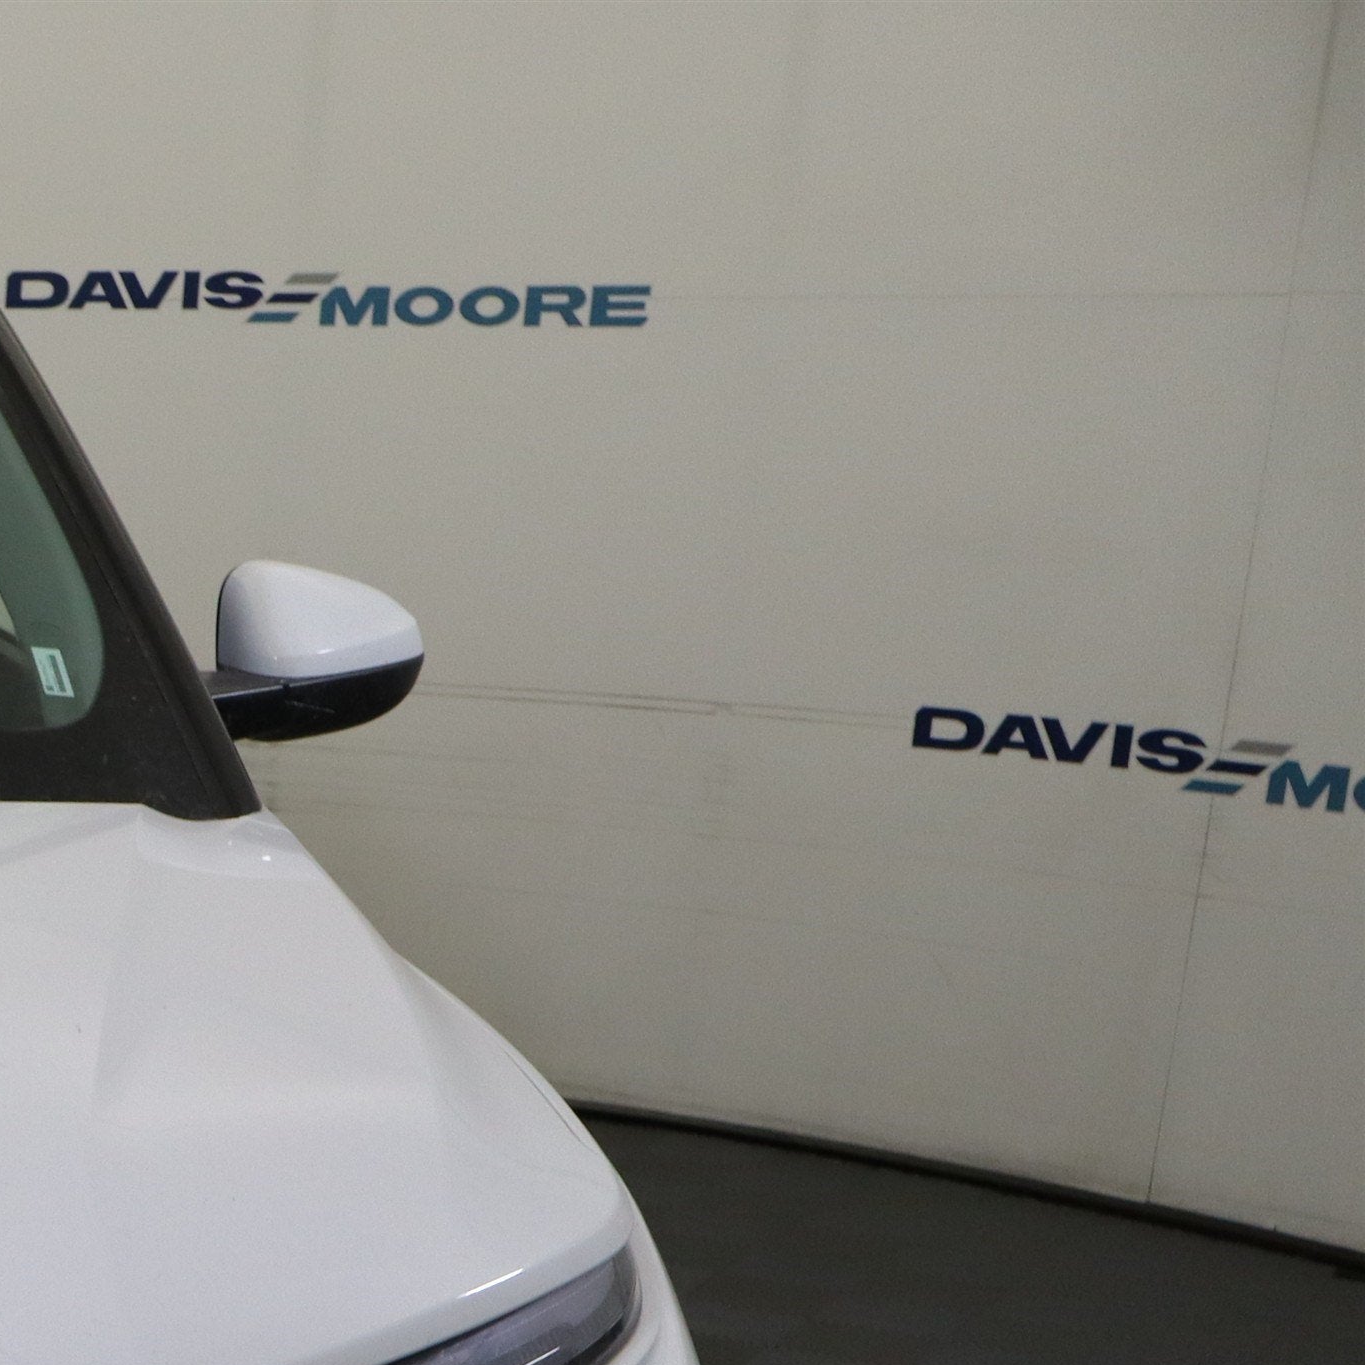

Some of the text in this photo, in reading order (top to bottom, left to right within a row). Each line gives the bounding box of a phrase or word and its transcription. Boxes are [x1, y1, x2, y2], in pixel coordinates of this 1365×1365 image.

[4, 271, 652, 327] DAVIS MOORE
[911, 705, 1207, 774] DAVIS
